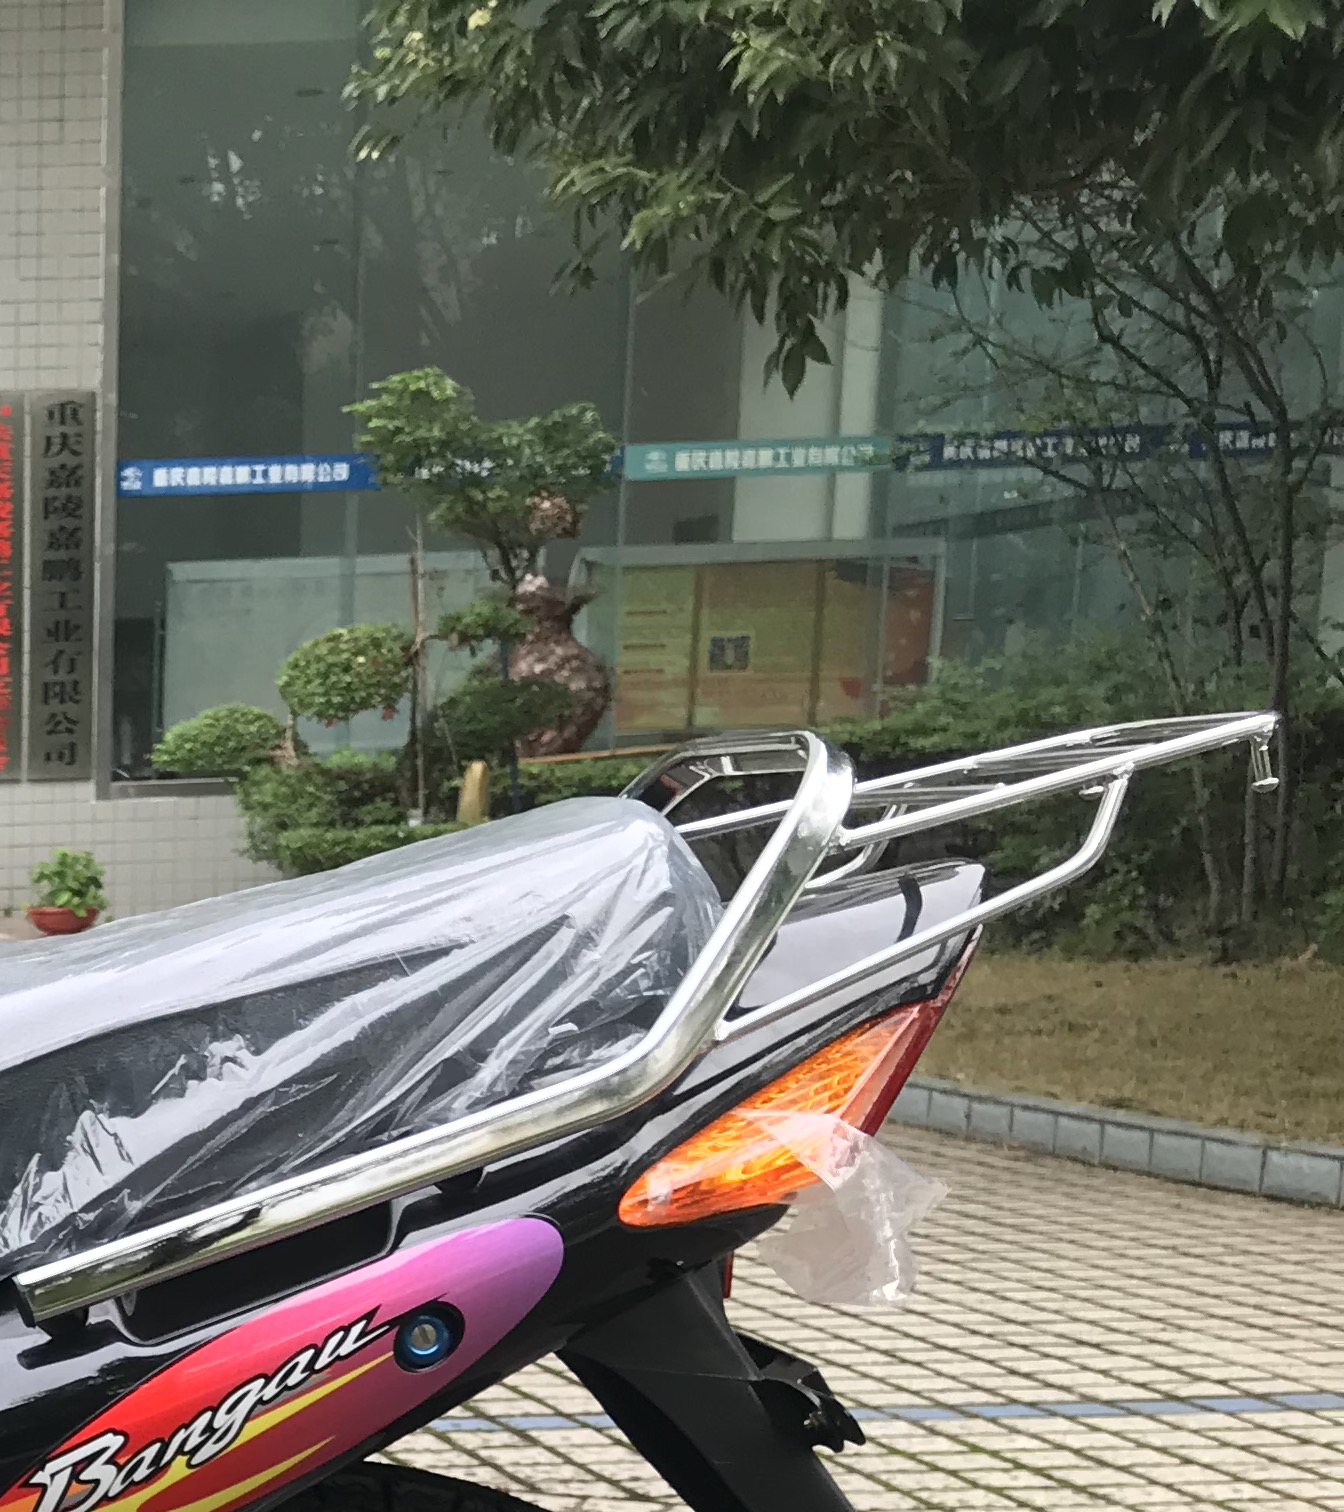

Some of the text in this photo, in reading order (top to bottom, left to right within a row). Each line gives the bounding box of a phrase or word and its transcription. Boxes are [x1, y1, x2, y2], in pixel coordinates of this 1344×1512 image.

[41, 400, 84, 766] 重庆嘉陵嘉鹏工业有限公司
